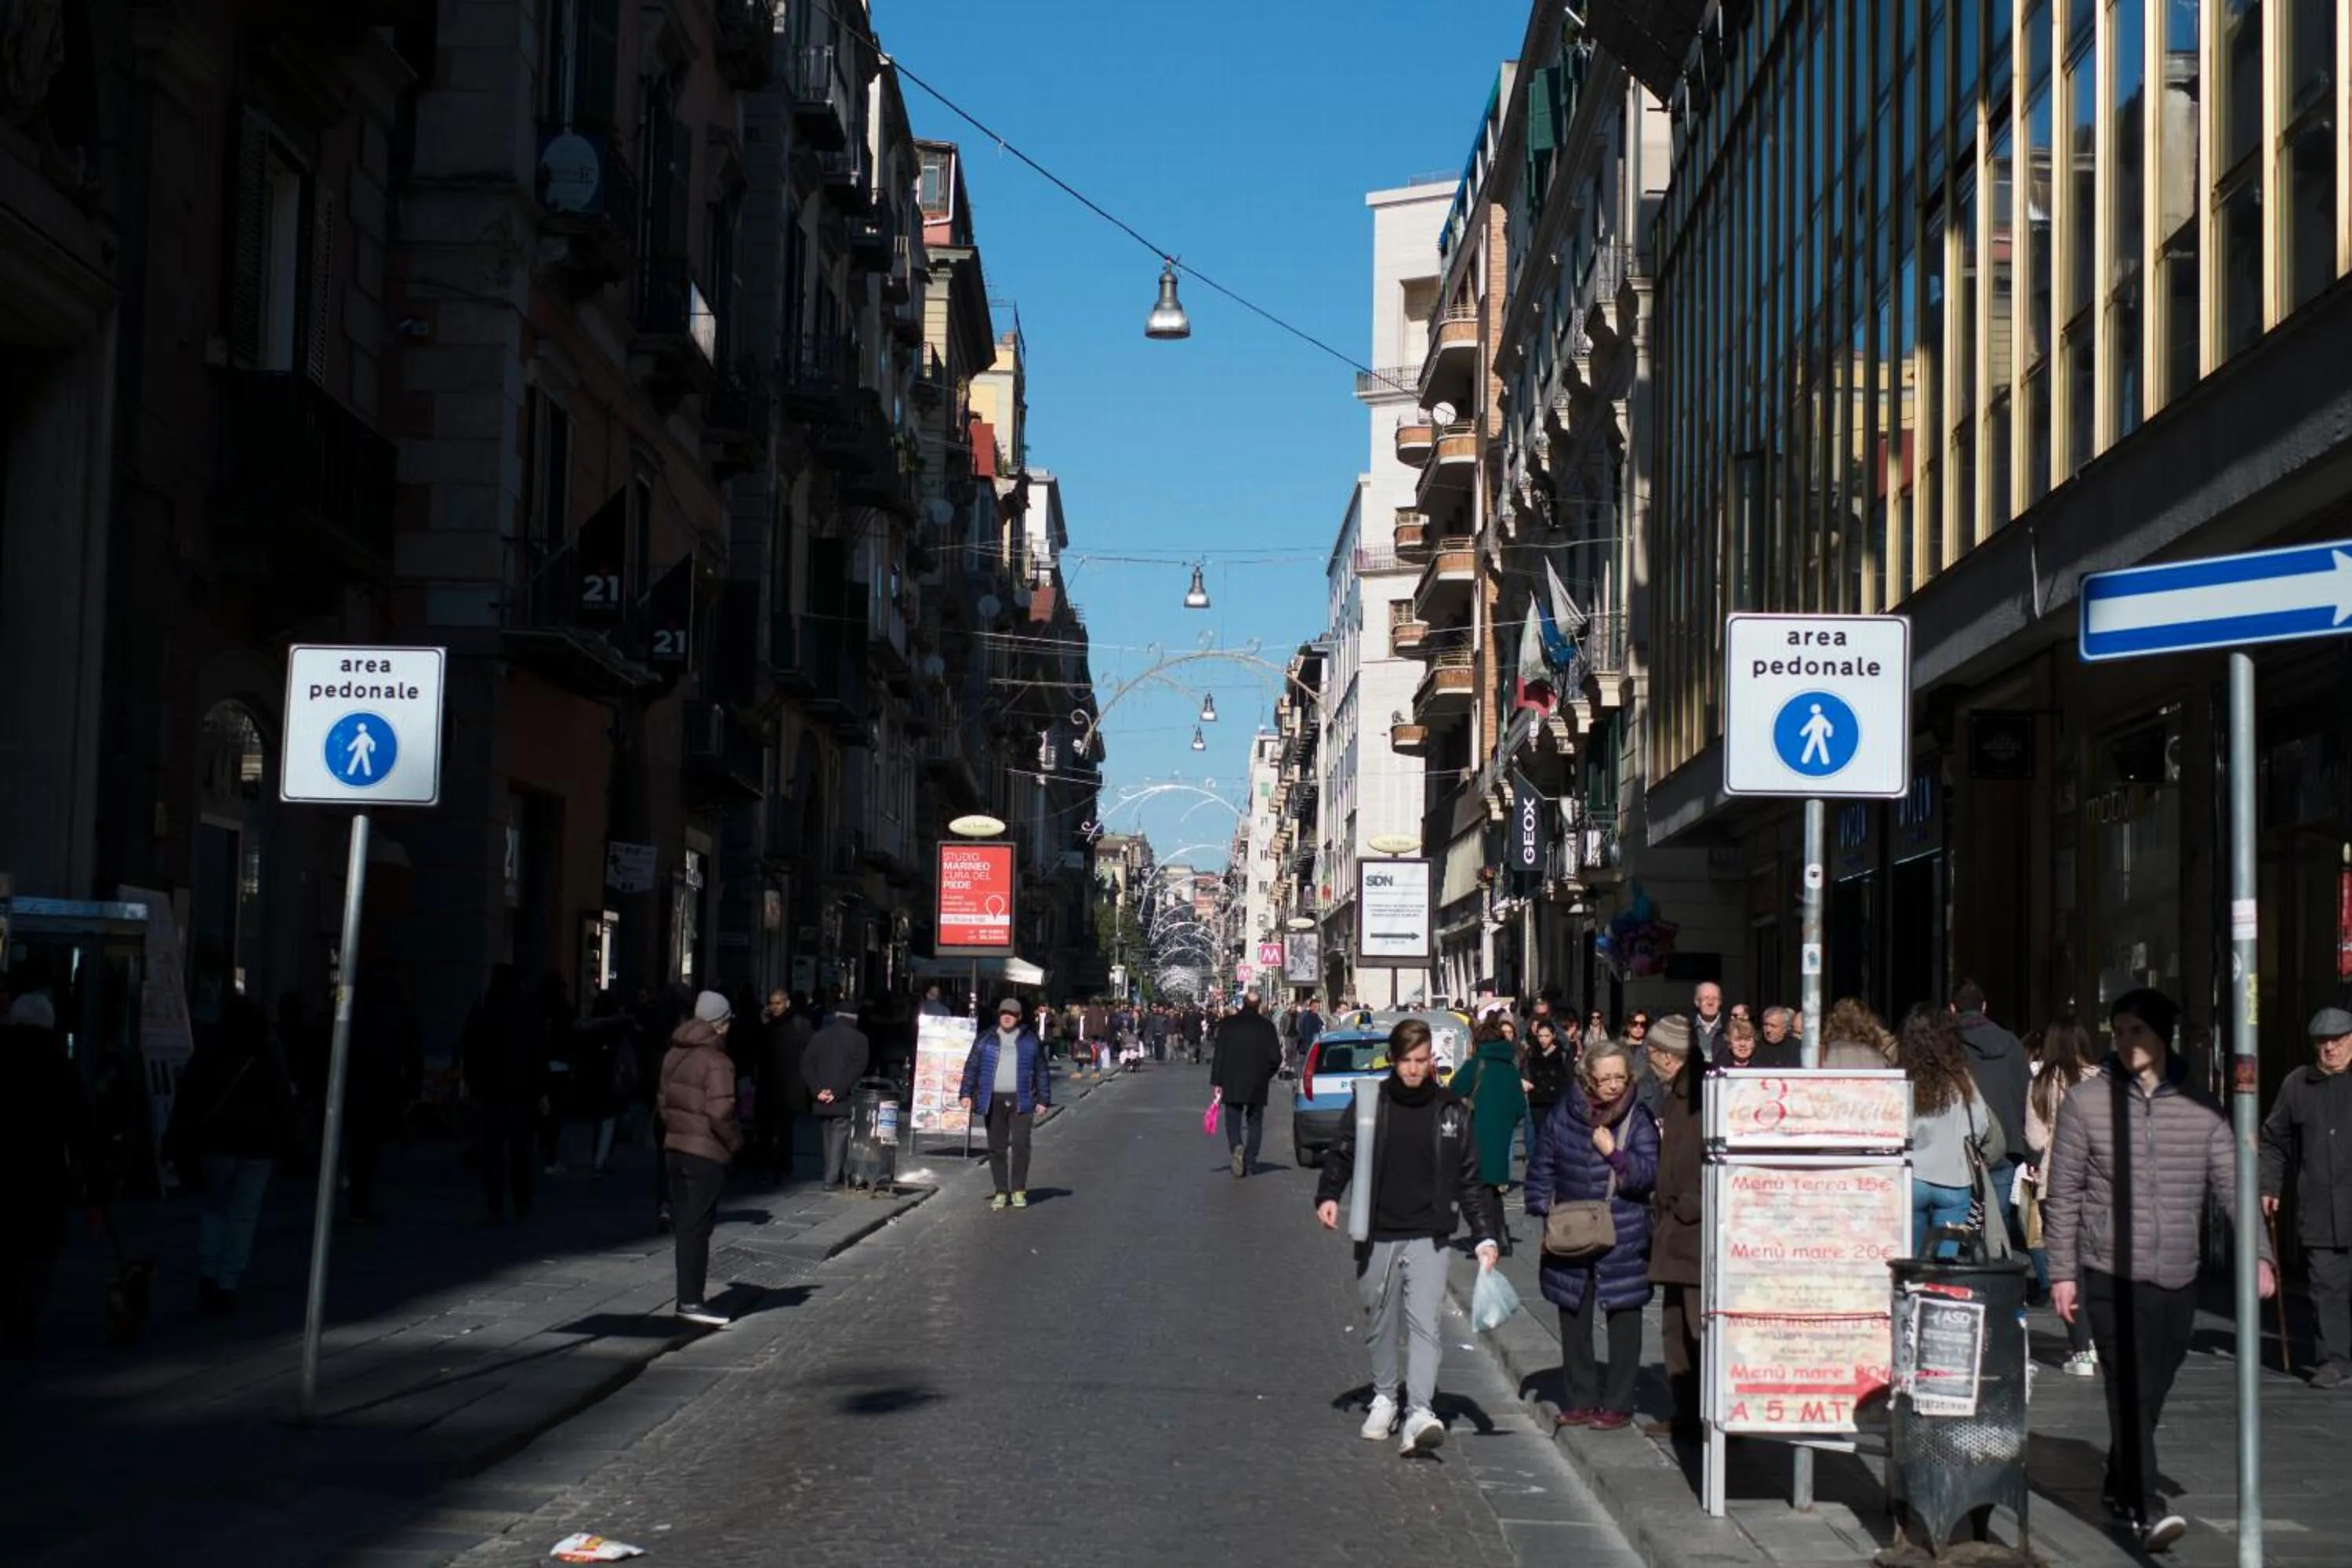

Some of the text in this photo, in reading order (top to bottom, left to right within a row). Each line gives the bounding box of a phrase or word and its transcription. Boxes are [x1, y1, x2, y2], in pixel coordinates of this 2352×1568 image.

[583, 574, 619, 602] 21
[652, 629, 687, 654] 21
[1787, 630, 1846, 646] area
[340, 659, 391, 673] area
[1752, 656, 1881, 678] pedonale
[309, 681, 419, 700] pedonale
[1523, 797, 1536, 865] GEOX
[943, 852, 979, 861] STUDIO
[943, 871, 992, 880] CURA DEL
[1366, 876, 1393, 887] SDN
[942, 880, 971, 889] PIEDE
[1261, 948, 1279, 962] M
[1731, 1176, 1784, 1191] Menù
[1792, 1178, 1848, 1190] terra
[1730, 1243, 1894, 1260] Menù mare 20€
[1730, 1364, 1785, 1379] Menù
[1793, 1367, 1844, 1379] mare
[1729, 1400, 1849, 1422] A 5 MT
